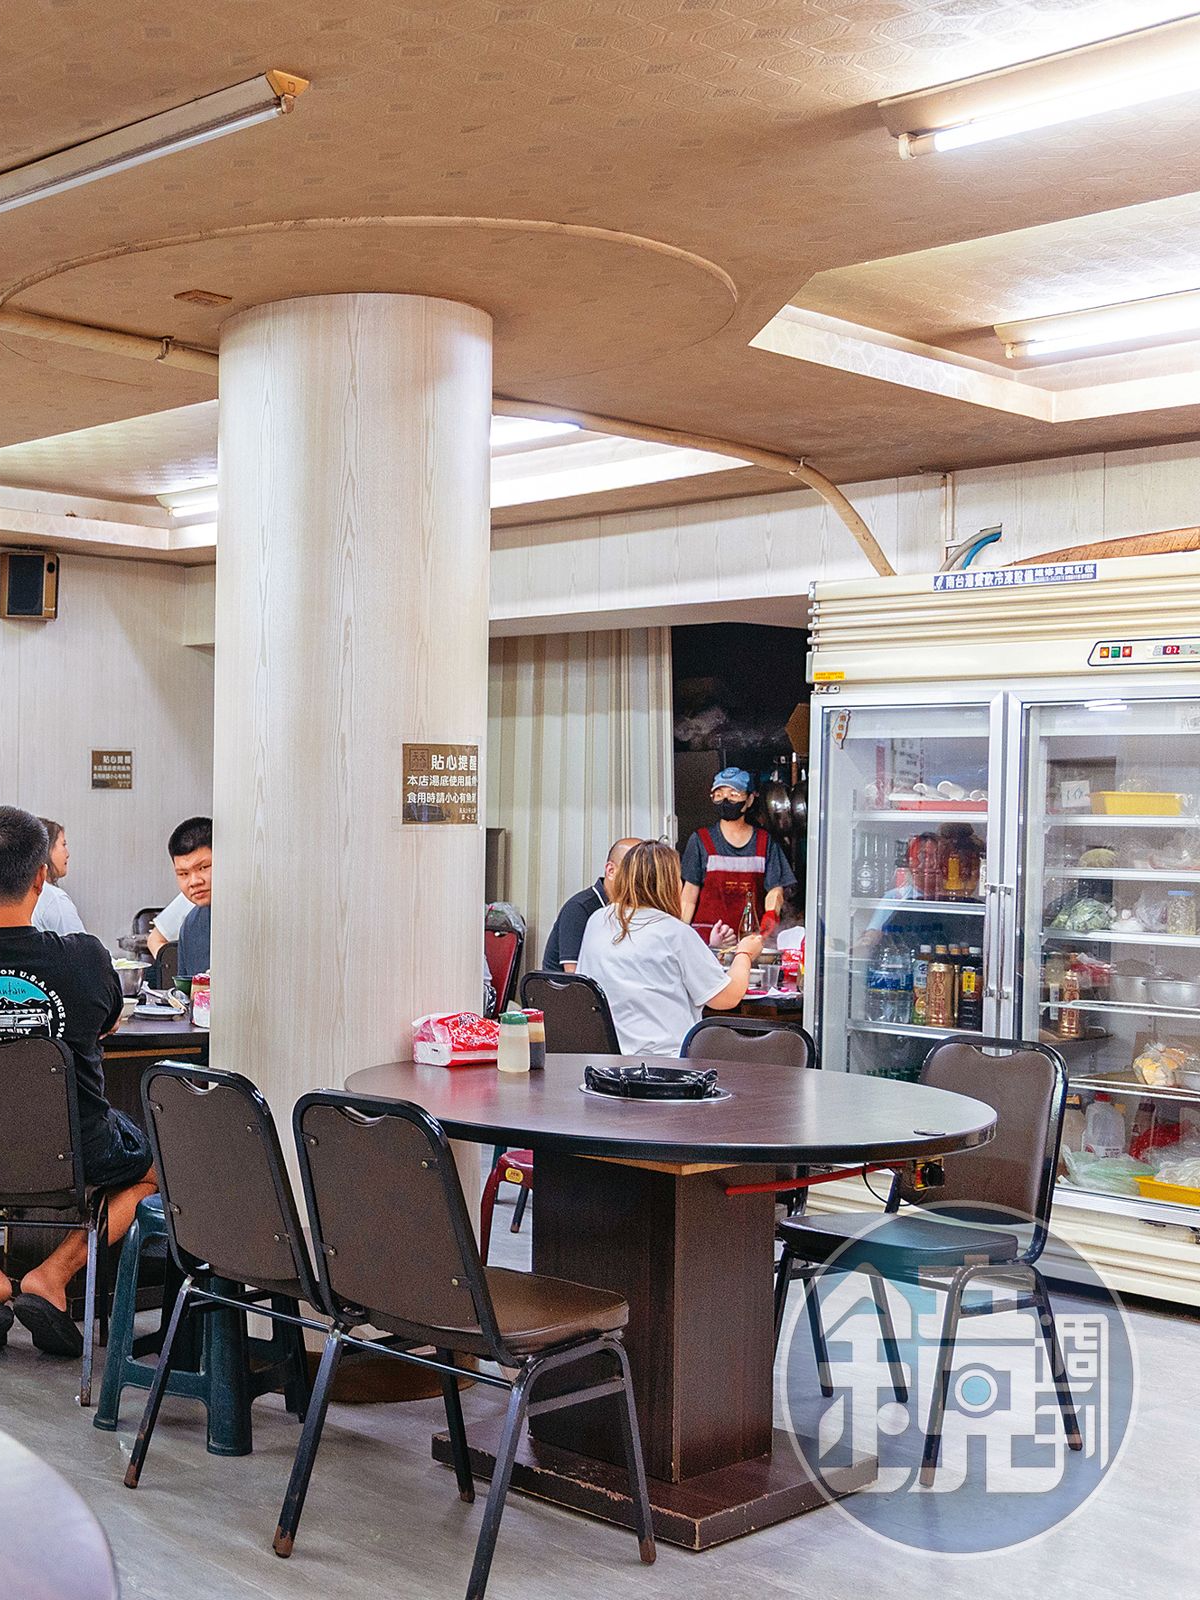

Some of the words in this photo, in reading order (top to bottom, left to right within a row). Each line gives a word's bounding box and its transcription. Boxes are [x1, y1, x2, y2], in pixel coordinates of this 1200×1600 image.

[20, 970, 47, 991] U.S.A.
[48, 990, 66, 1019] SINCE
[56, 1021, 65, 1039] 194
